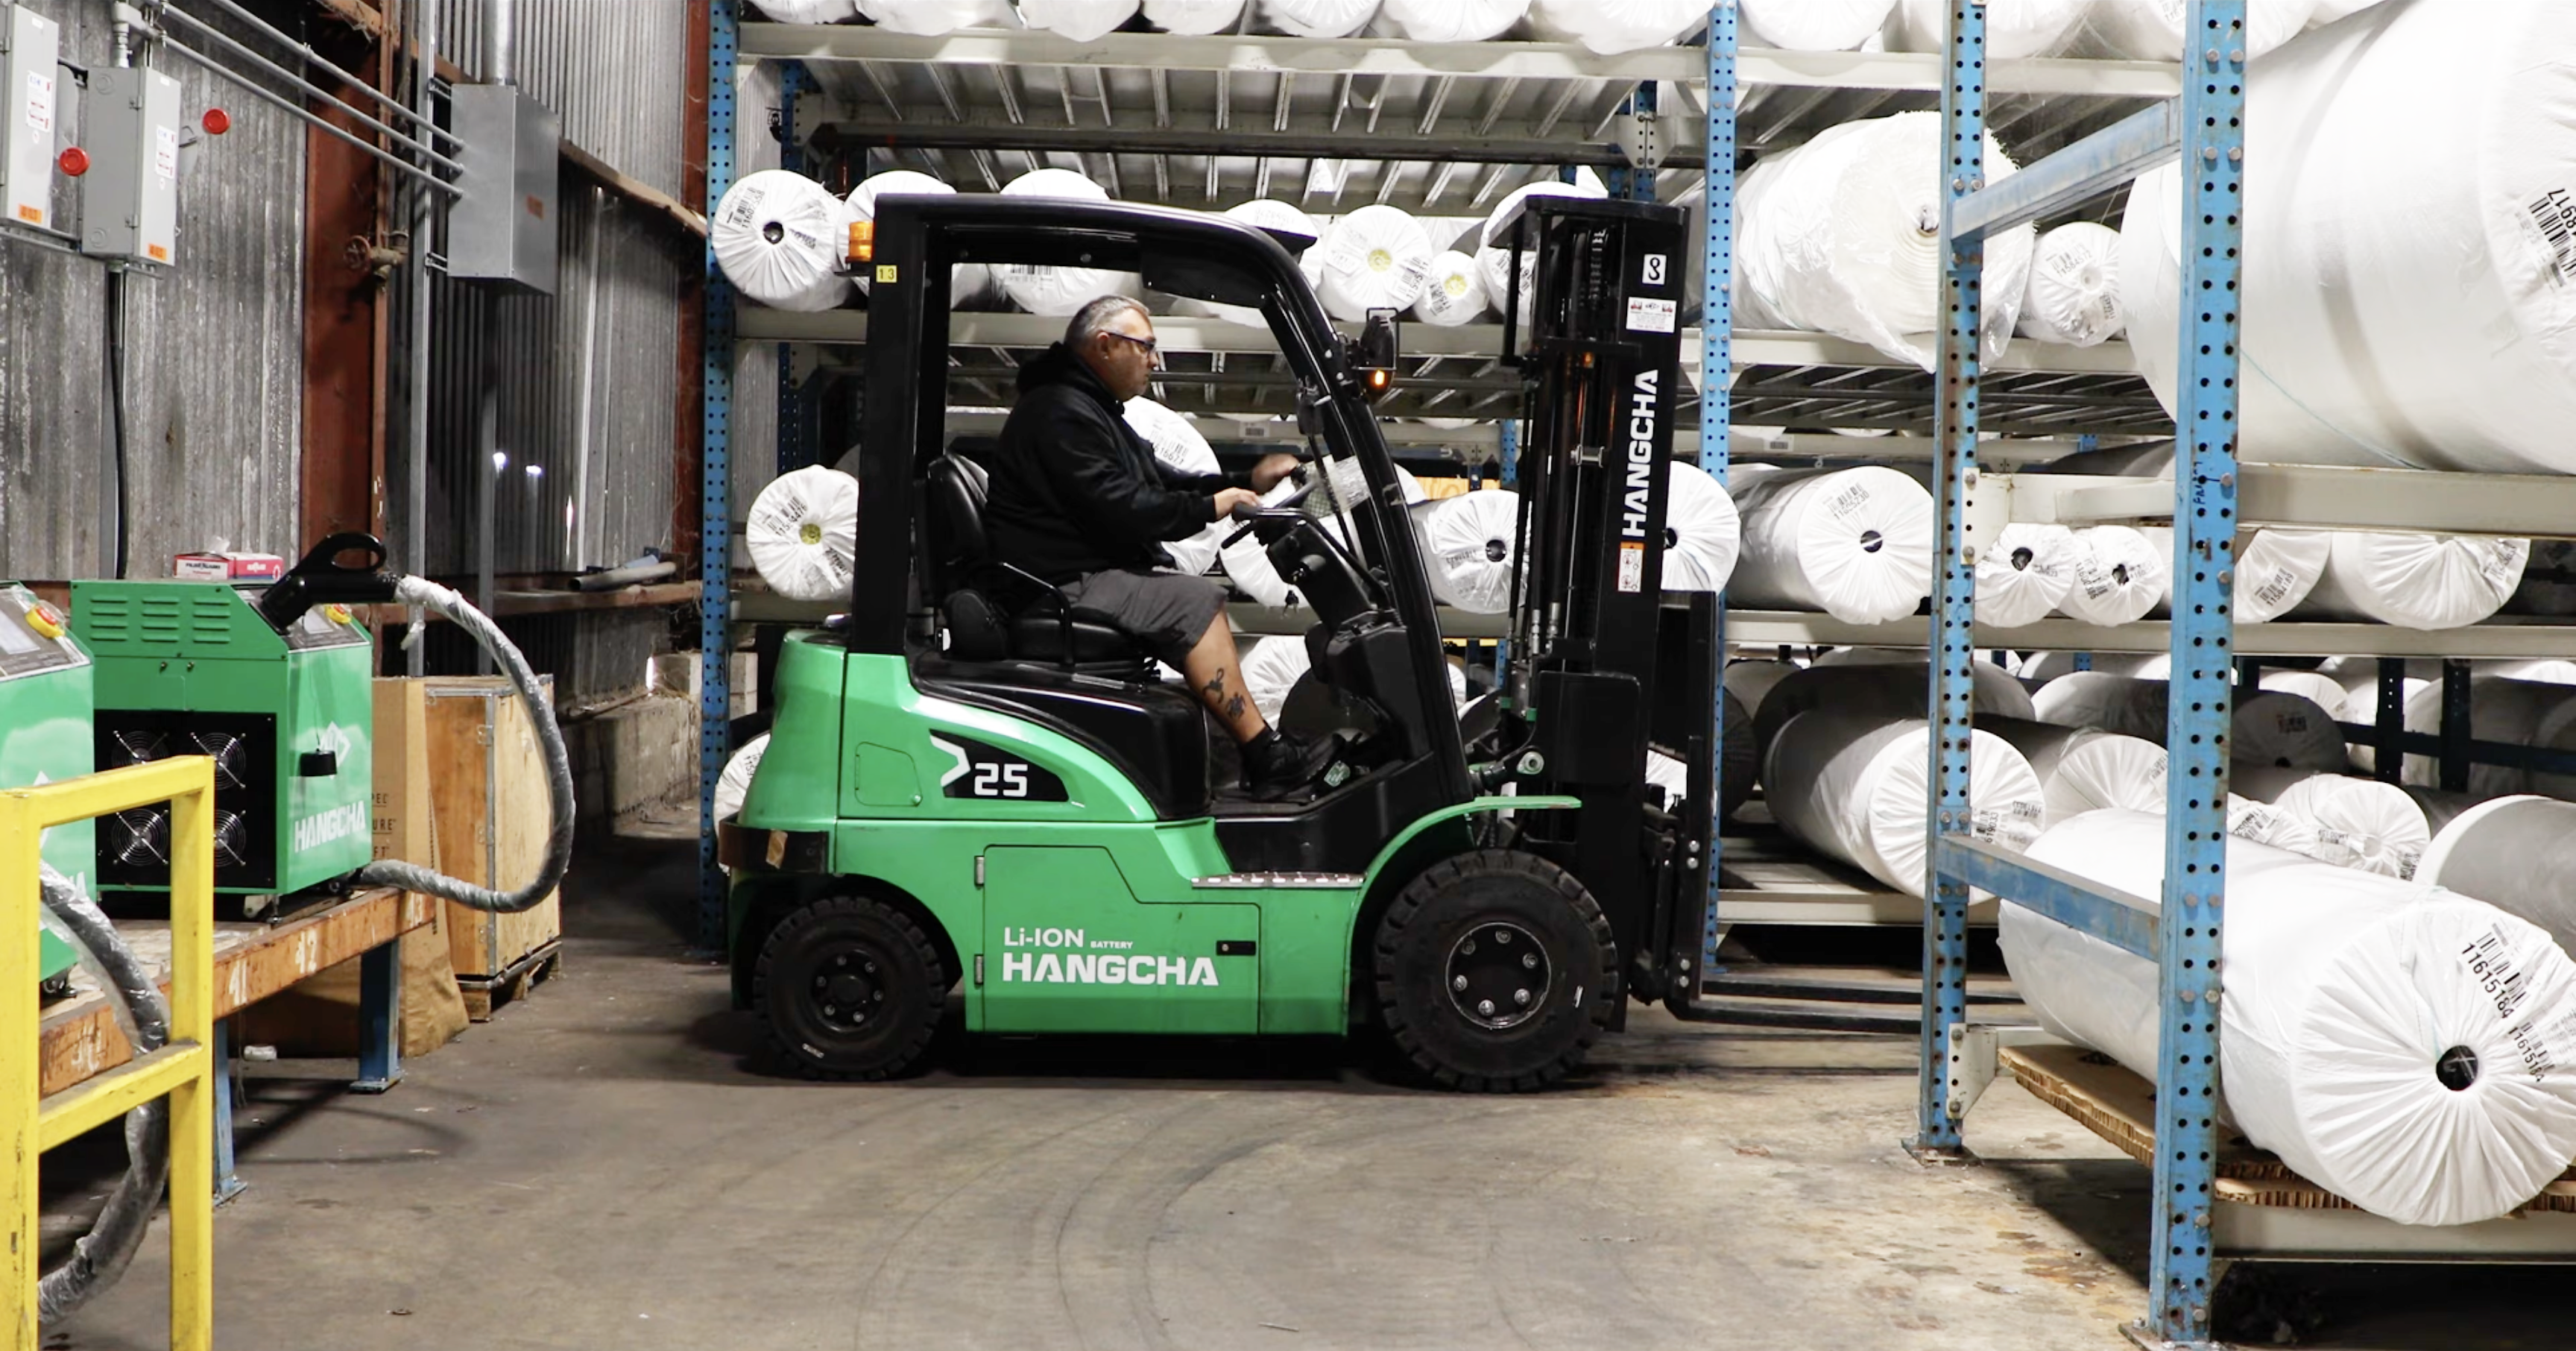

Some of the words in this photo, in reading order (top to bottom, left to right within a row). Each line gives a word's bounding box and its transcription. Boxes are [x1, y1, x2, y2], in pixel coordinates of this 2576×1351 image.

[1621, 369, 1659, 538] HANGCHA
[974, 762, 1029, 798] 25
[294, 799, 366, 854] HANGCHA
[1004, 927, 1085, 948] Li-ION
[1090, 940, 1134, 949] BATTERY
[1003, 952, 1219, 986] HANGCHA
[2461, 942, 2515, 1019] 11615184
[2508, 1026, 2546, 1083] 11615184
